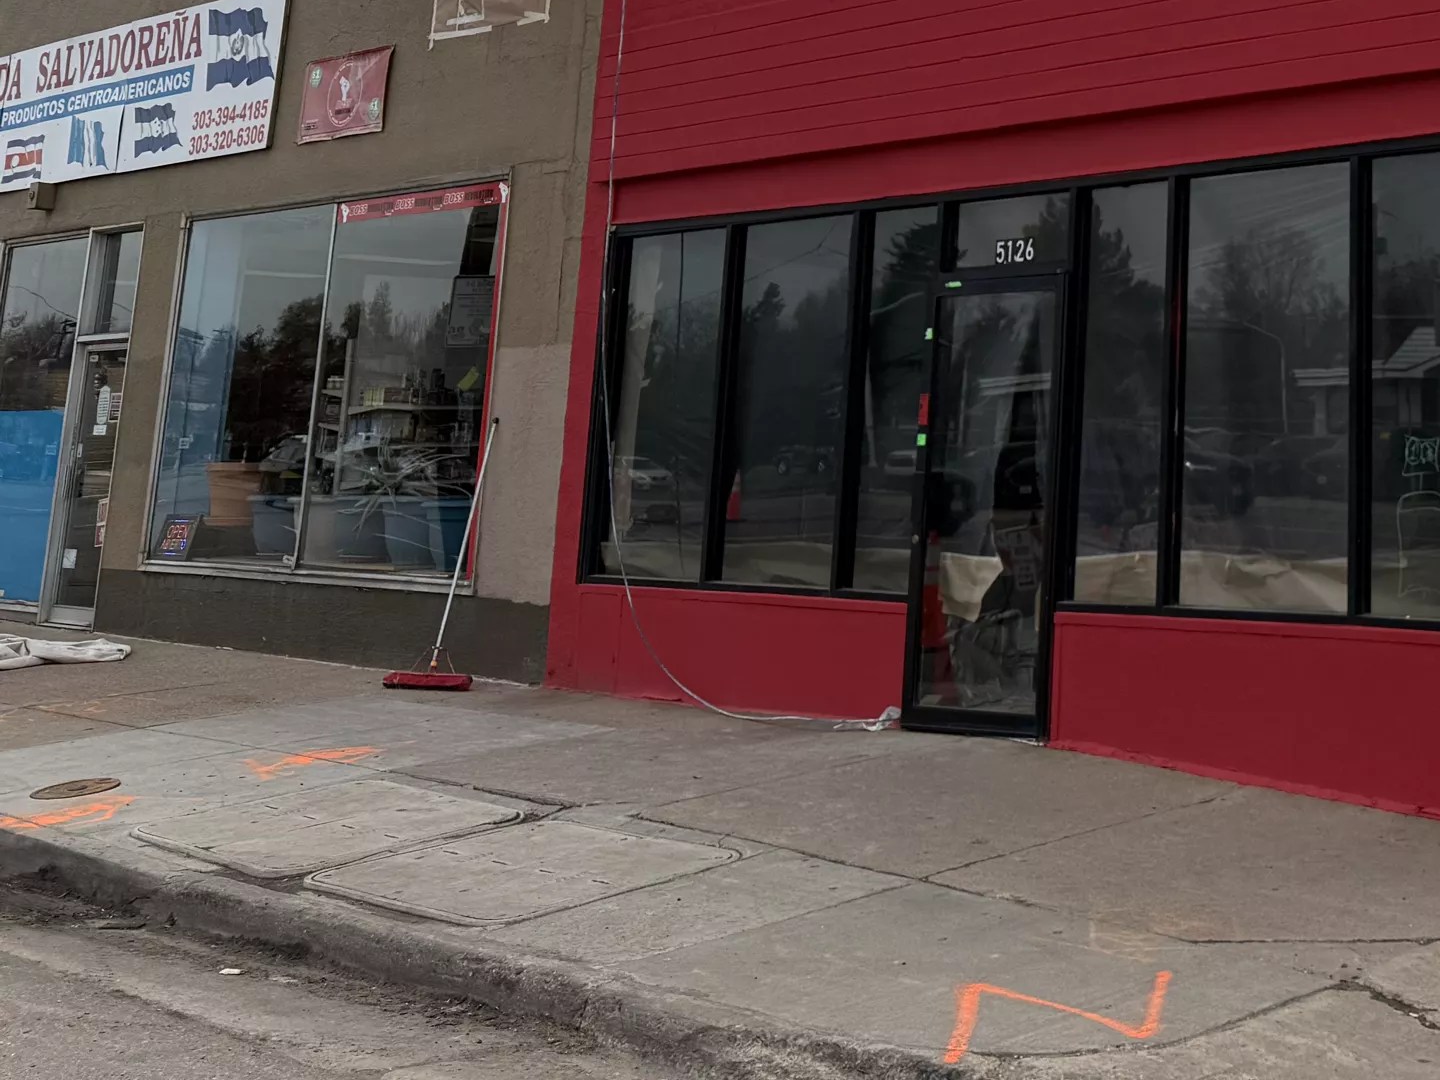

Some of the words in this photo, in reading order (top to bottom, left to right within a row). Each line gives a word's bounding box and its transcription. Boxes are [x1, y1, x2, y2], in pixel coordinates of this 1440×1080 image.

[36, 10, 203, 94] SALVADOREÑA
[1, 98, 66, 128] PRODUCTOS
[67, 71, 191, 113] CENTROAMERICANOS
[192, 99, 269, 131] 303-394-4185
[188, 124, 266, 156] 303-320-6306
[443, 191, 465, 205] BOSS
[996, 238, 1034, 264] 5126
